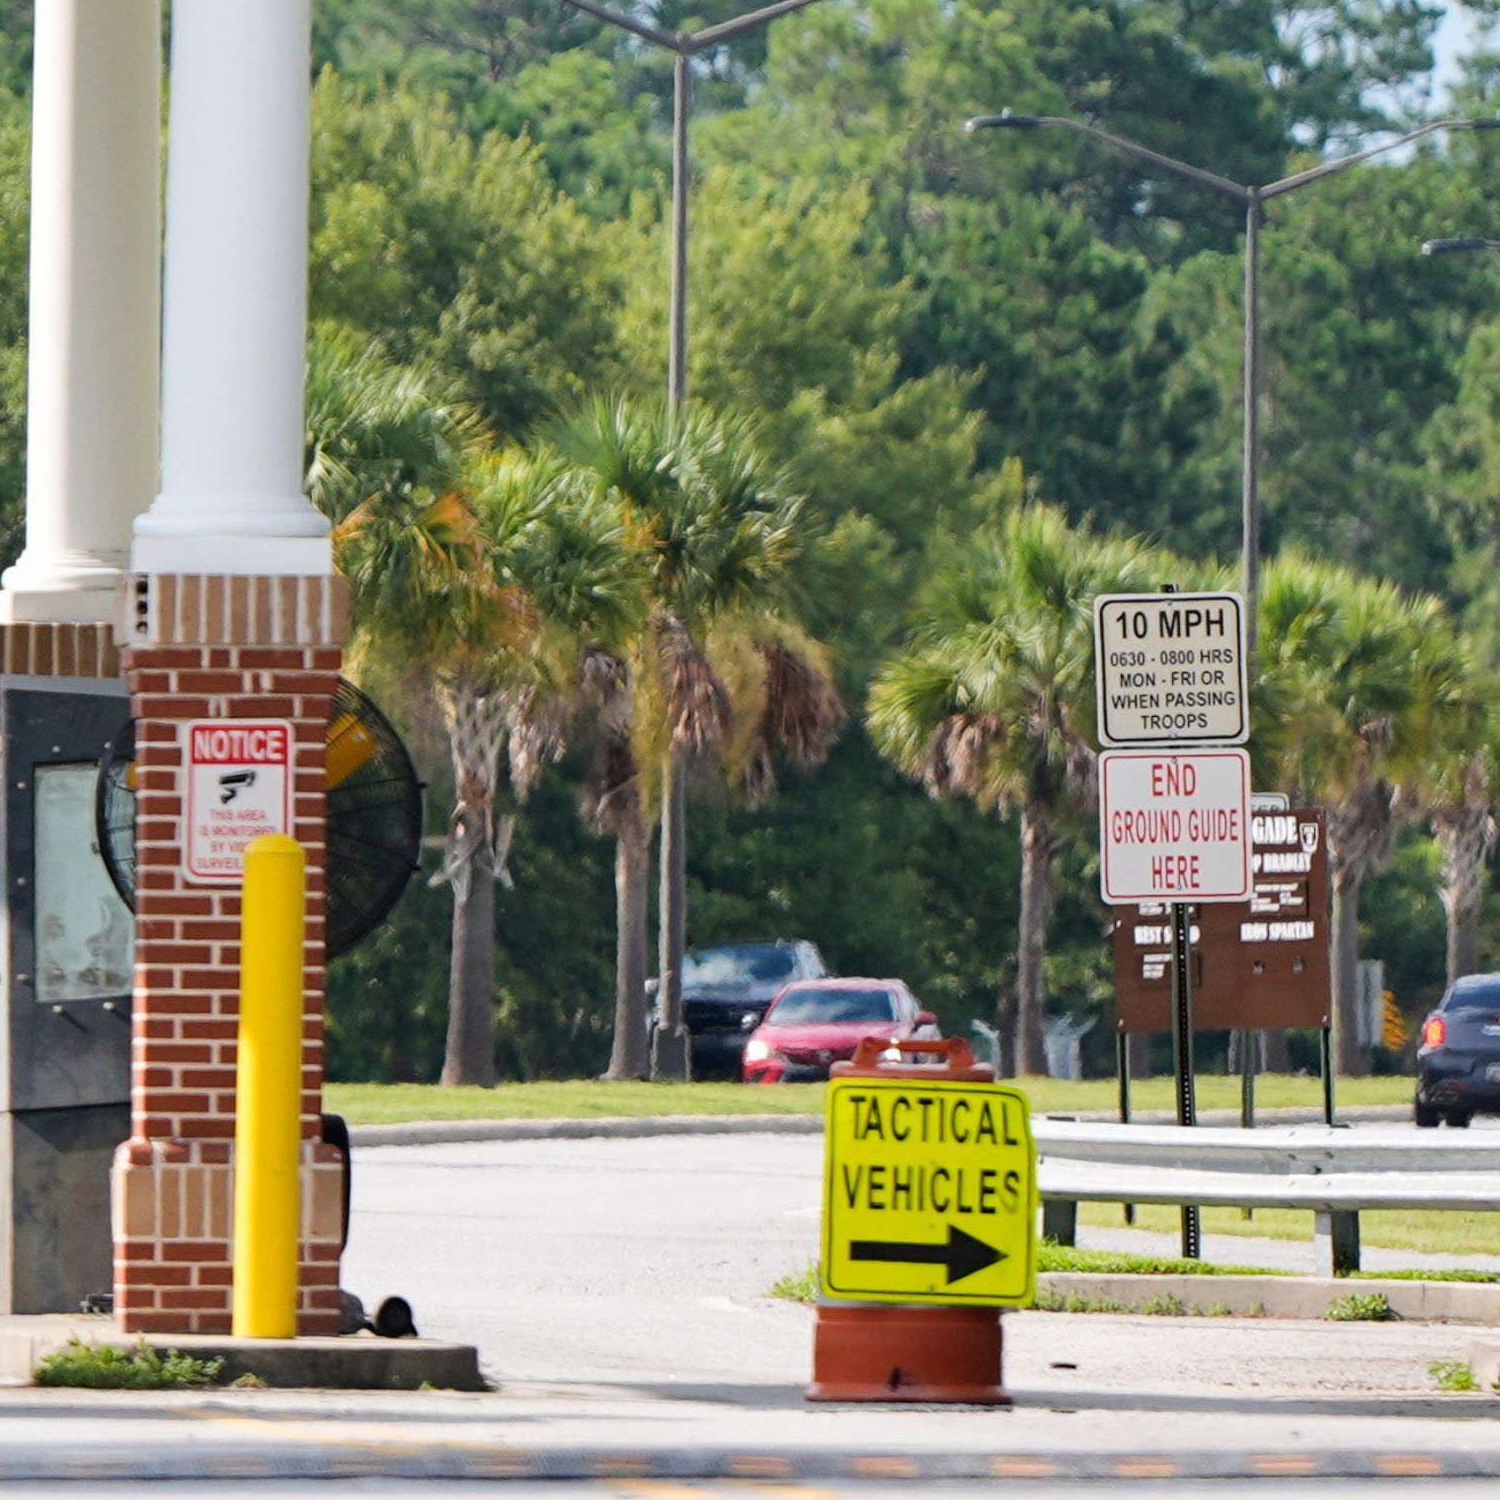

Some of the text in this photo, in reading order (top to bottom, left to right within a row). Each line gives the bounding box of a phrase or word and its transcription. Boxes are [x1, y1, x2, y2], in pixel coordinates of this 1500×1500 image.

[1116, 609, 1225, 639] 10 MPH
[1110, 650, 1146, 667] 0630
[1160, 650, 1195, 666] 0800
[1200, 649, 1233, 664] HRS
[1119, 672, 1155, 689] MON
[1171, 671, 1196, 687] FRI
[1200, 670, 1225, 686] OR
[1111, 691, 1235, 710] WHEN PASSING
[1140, 713, 1208, 730] TROOPS
[194, 730, 285, 760] NOTICE
[1151, 763, 1197, 797] END
[1112, 809, 1239, 844] GROUND GUIDE
[1252, 815, 1298, 845] GADE
[1152, 855, 1200, 889] HERE
[849, 1095, 1019, 1146] TACTICAL
[842, 1163, 1022, 1215] VEHICLES
